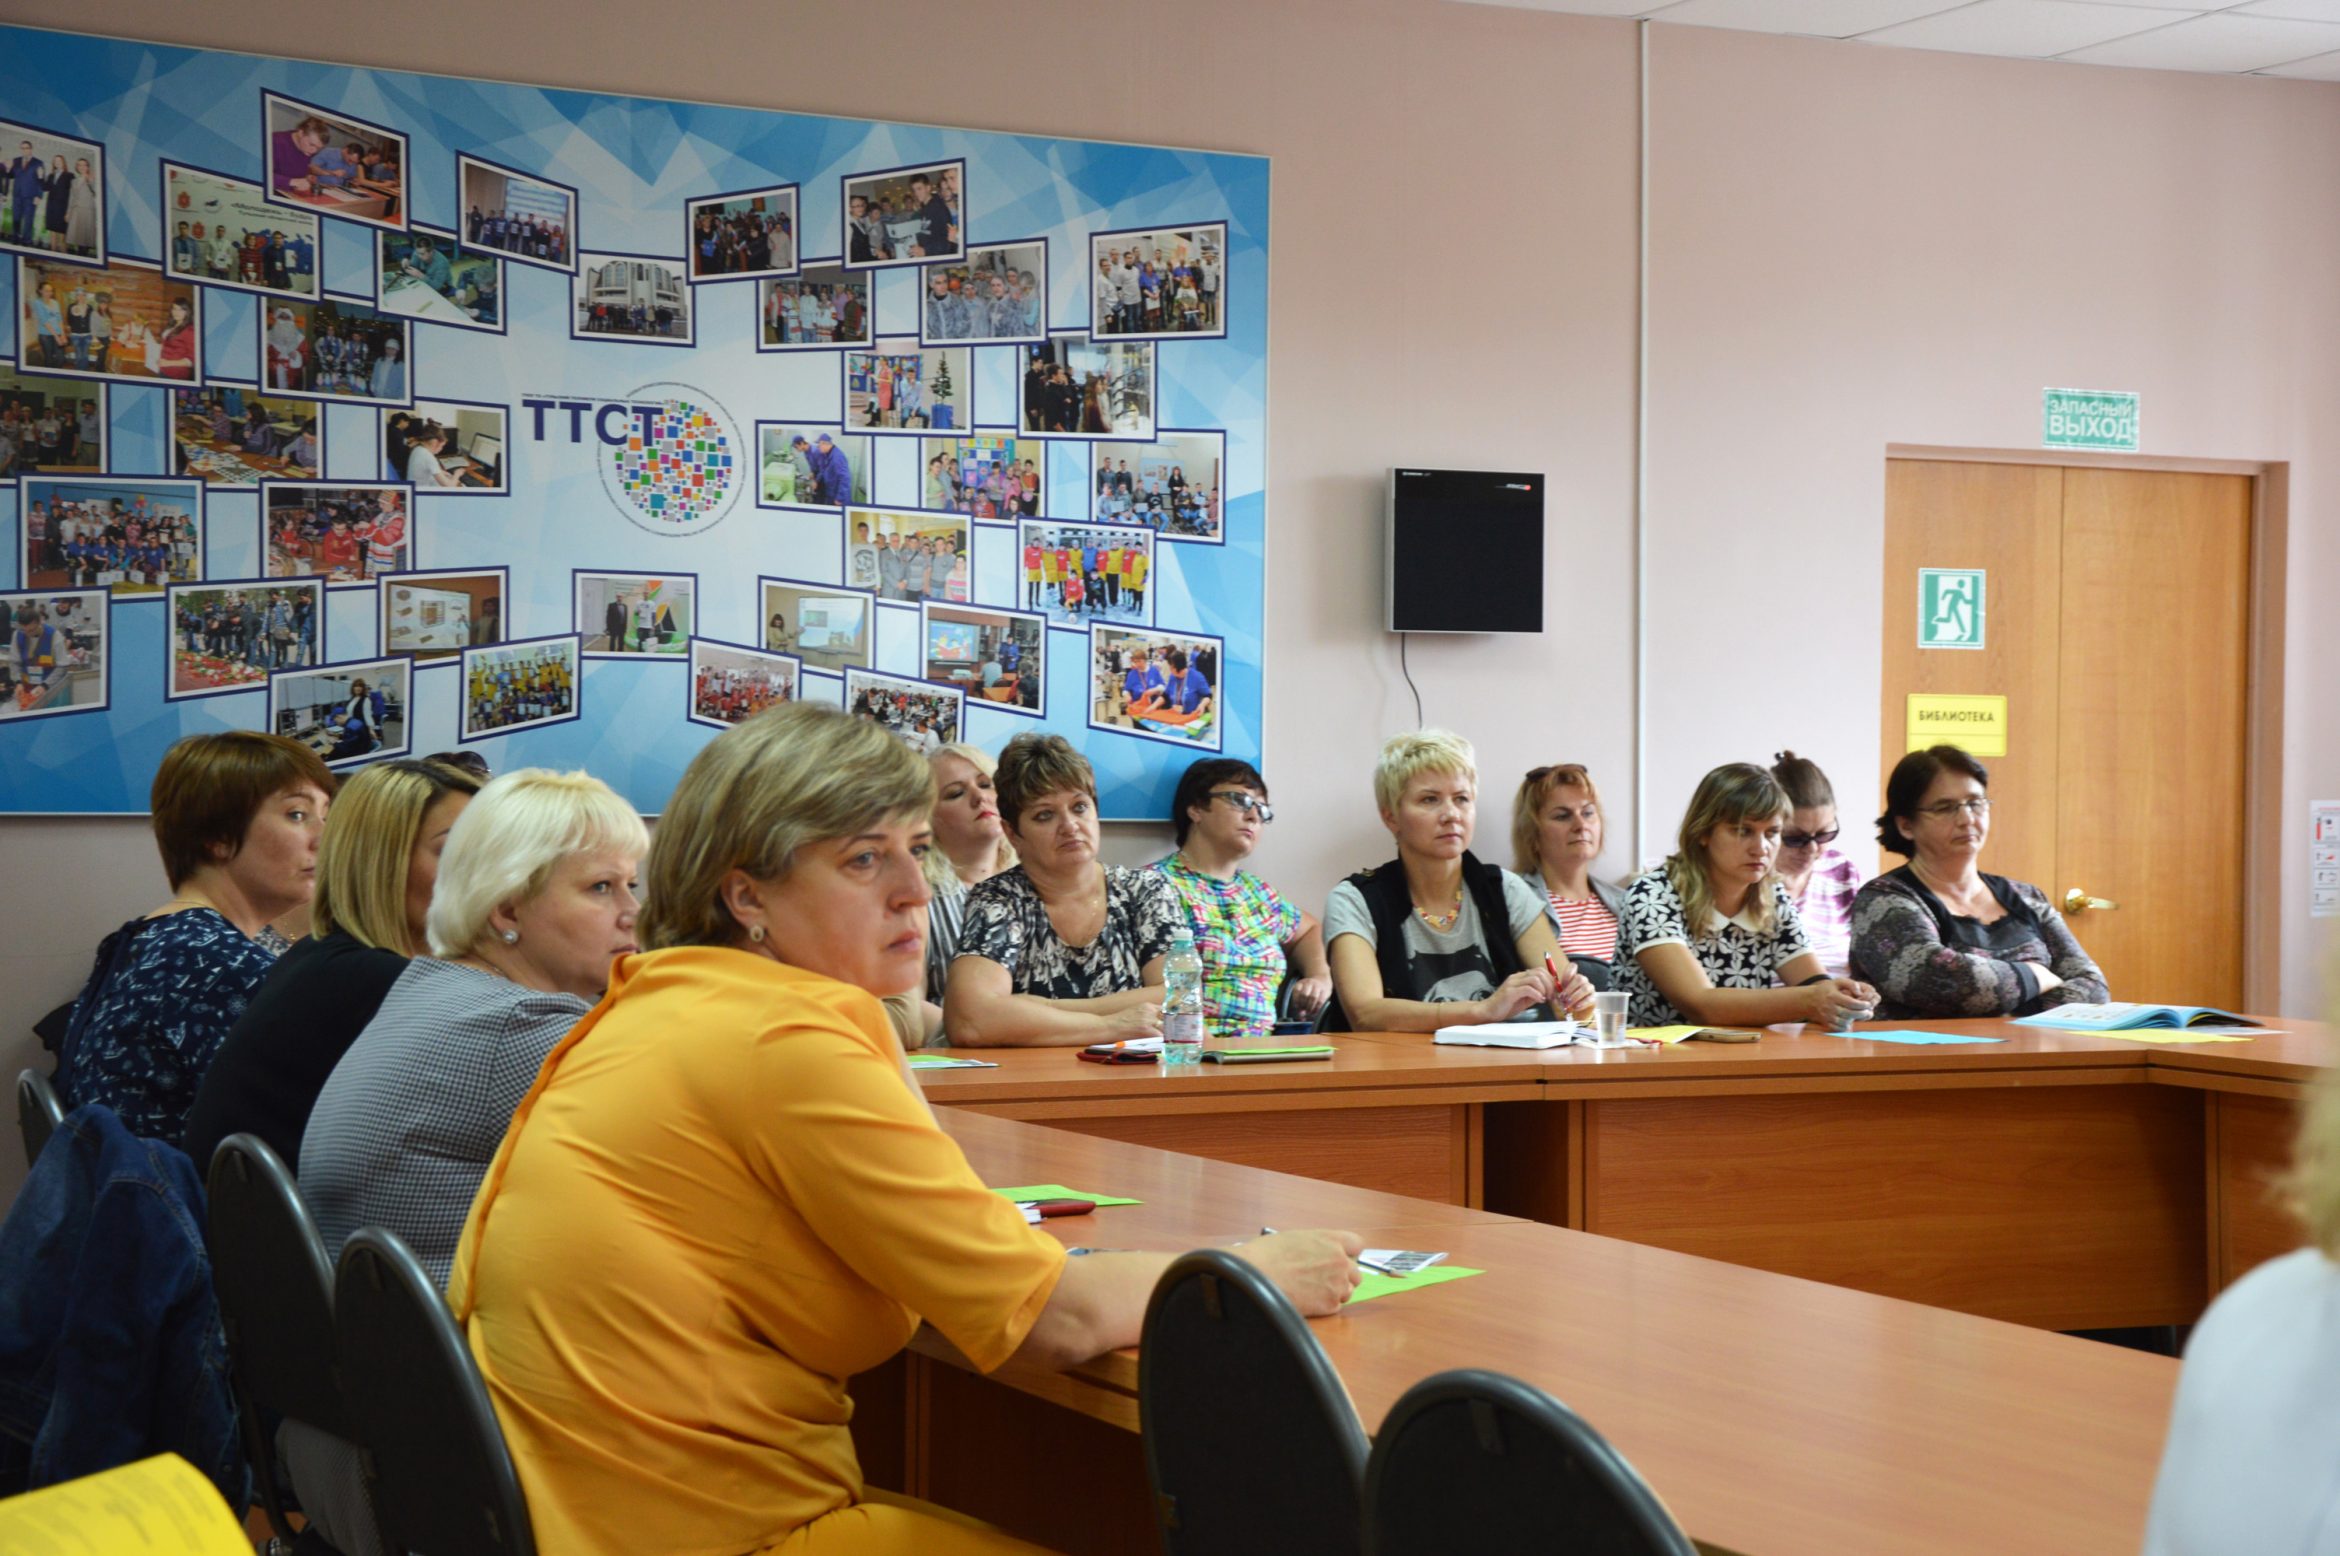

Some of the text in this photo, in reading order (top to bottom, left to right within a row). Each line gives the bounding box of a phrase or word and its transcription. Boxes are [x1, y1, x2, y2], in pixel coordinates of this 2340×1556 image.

[2050, 399, 2132, 417] ЗАПАСНЫЙ
[522, 399, 663, 447] ТТСТ
[2050, 414, 2132, 443] ВЫХОД
[1919, 709, 1995, 722] БИБЛИОТЕКА
